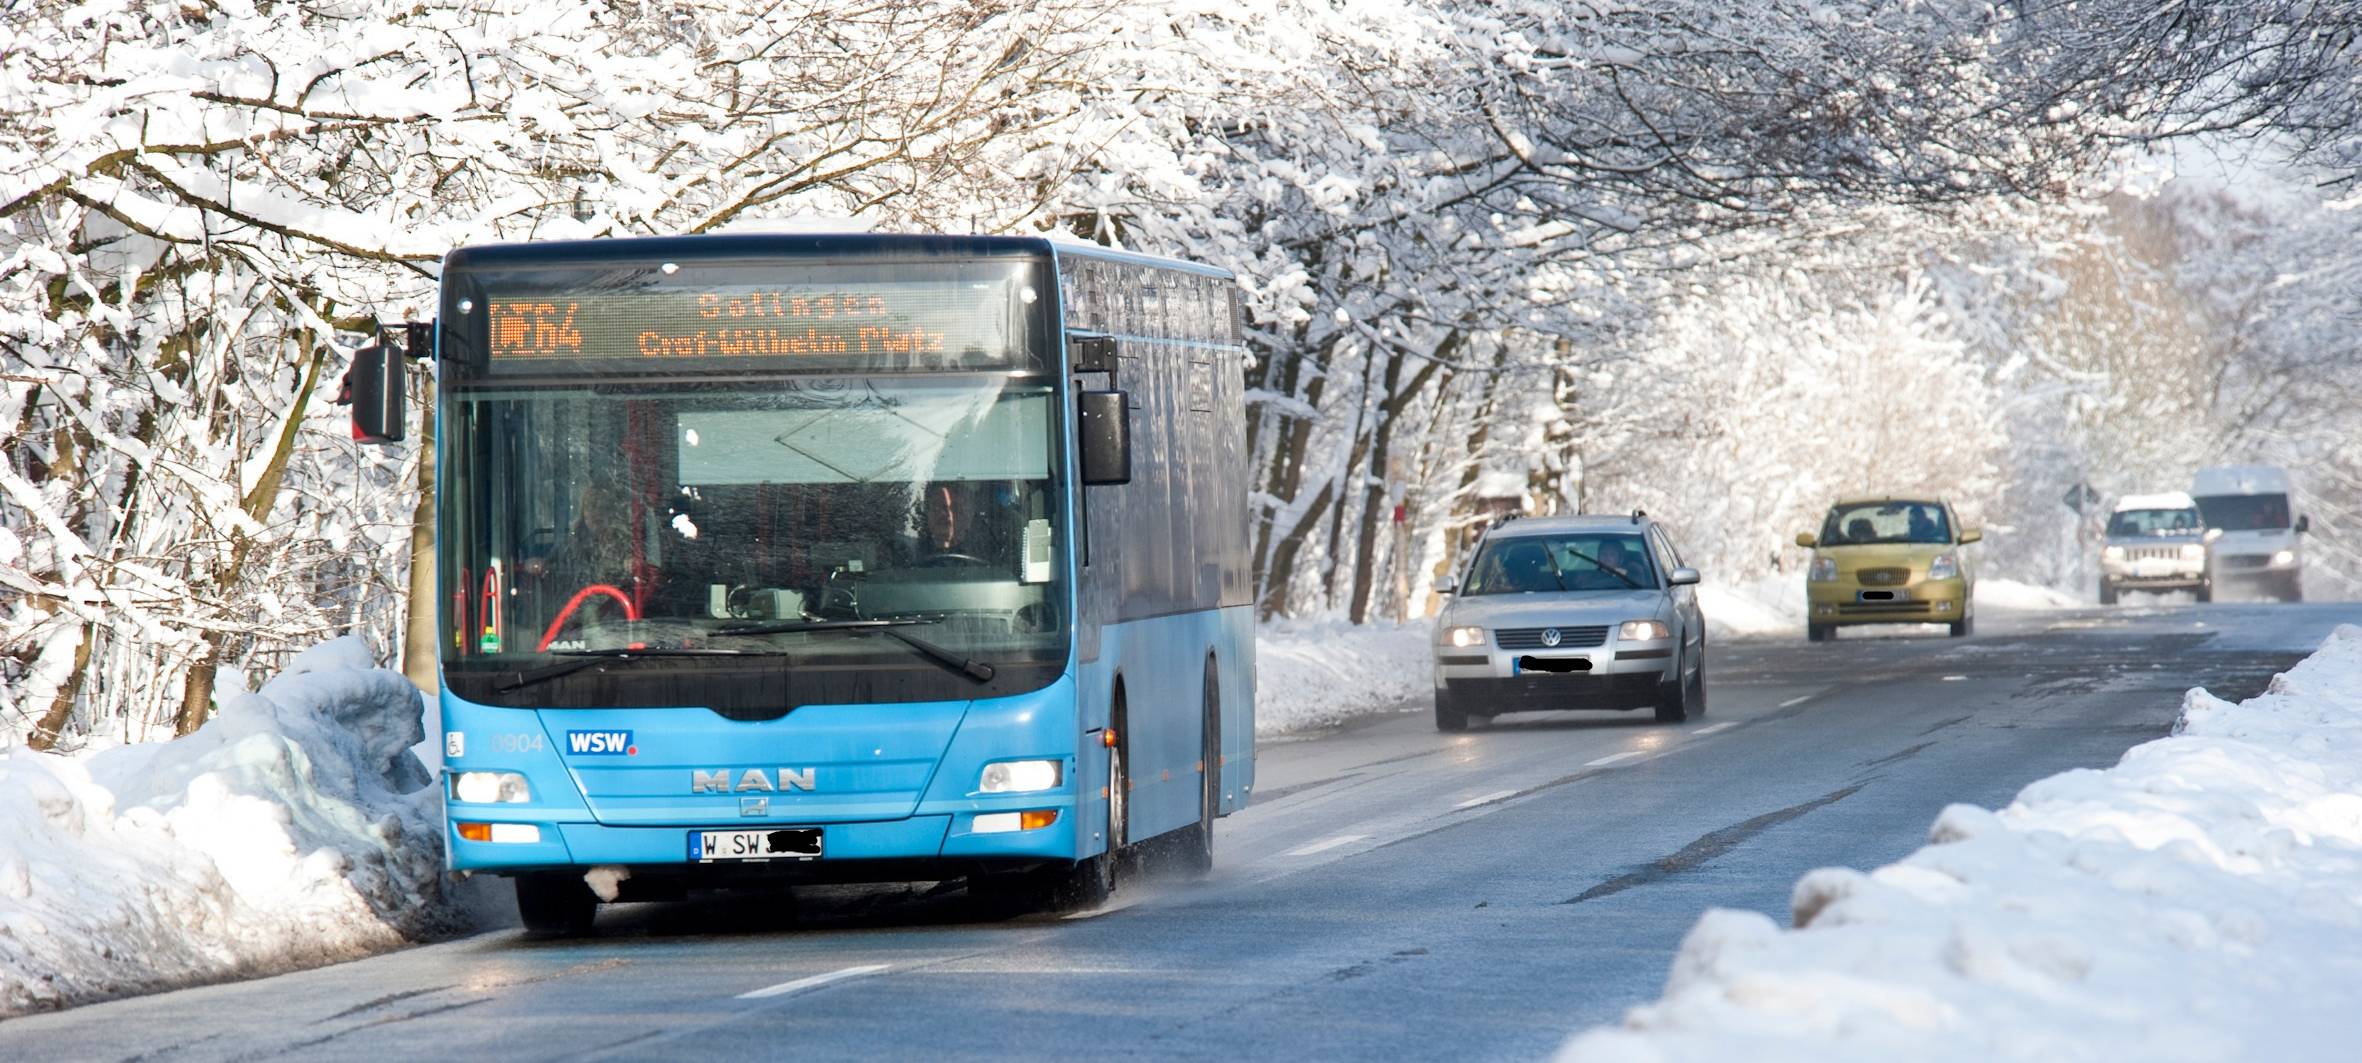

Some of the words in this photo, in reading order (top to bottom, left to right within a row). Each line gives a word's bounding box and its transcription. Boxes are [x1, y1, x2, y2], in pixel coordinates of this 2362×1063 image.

[698, 290, 885, 320] Solingen
[569, 732, 627, 753] WSW
[692, 767, 816, 793] MAN
[704, 835, 717, 855] W
